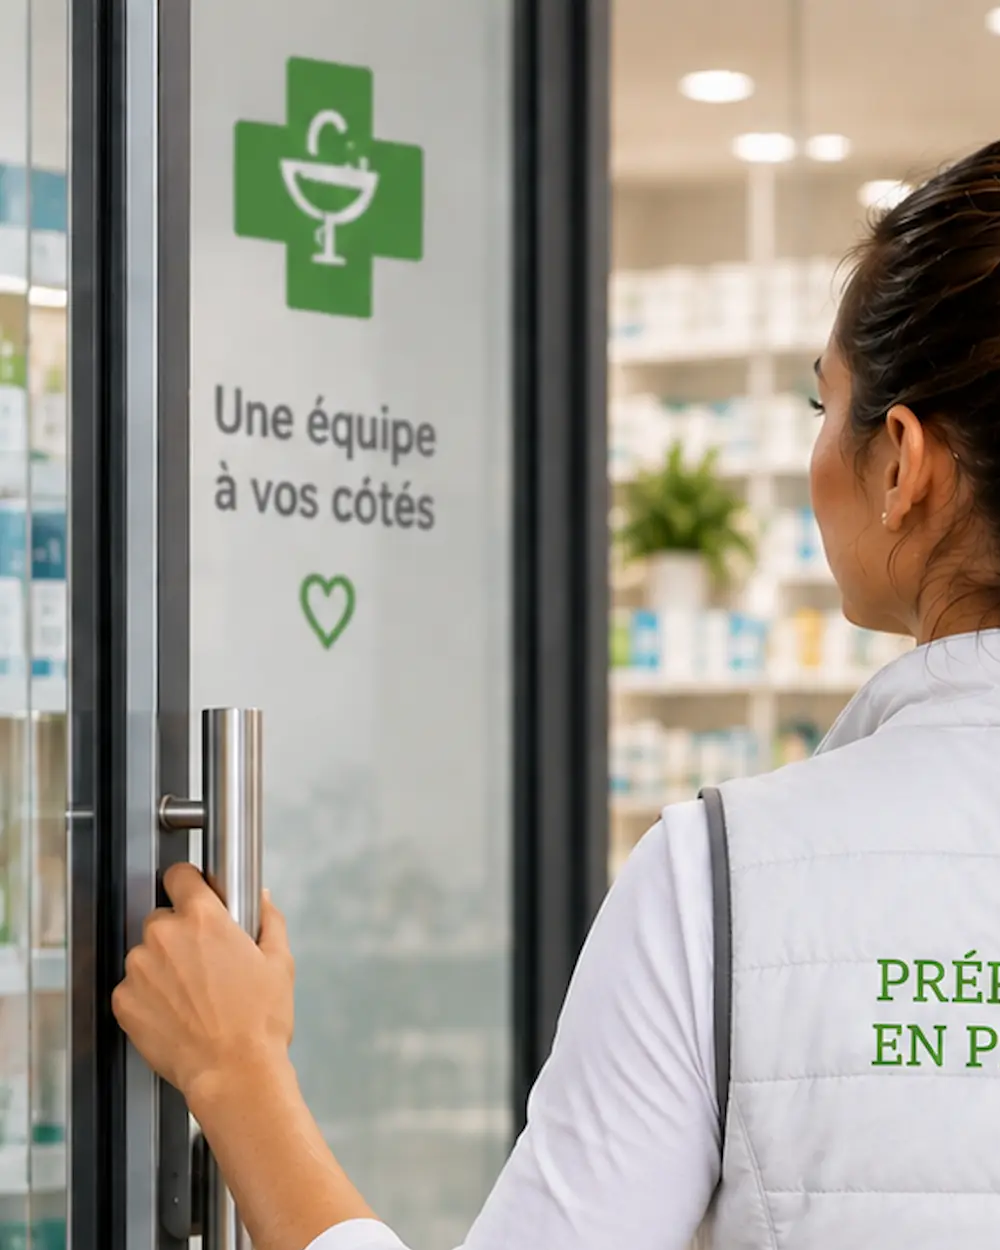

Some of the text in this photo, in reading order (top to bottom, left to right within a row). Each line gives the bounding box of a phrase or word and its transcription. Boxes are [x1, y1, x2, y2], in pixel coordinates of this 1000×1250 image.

[214, 384, 437, 467] Une équipe
[214, 460, 237, 511] à
[250, 477, 319, 520] vos
[871, 1023, 947, 1067] EN
